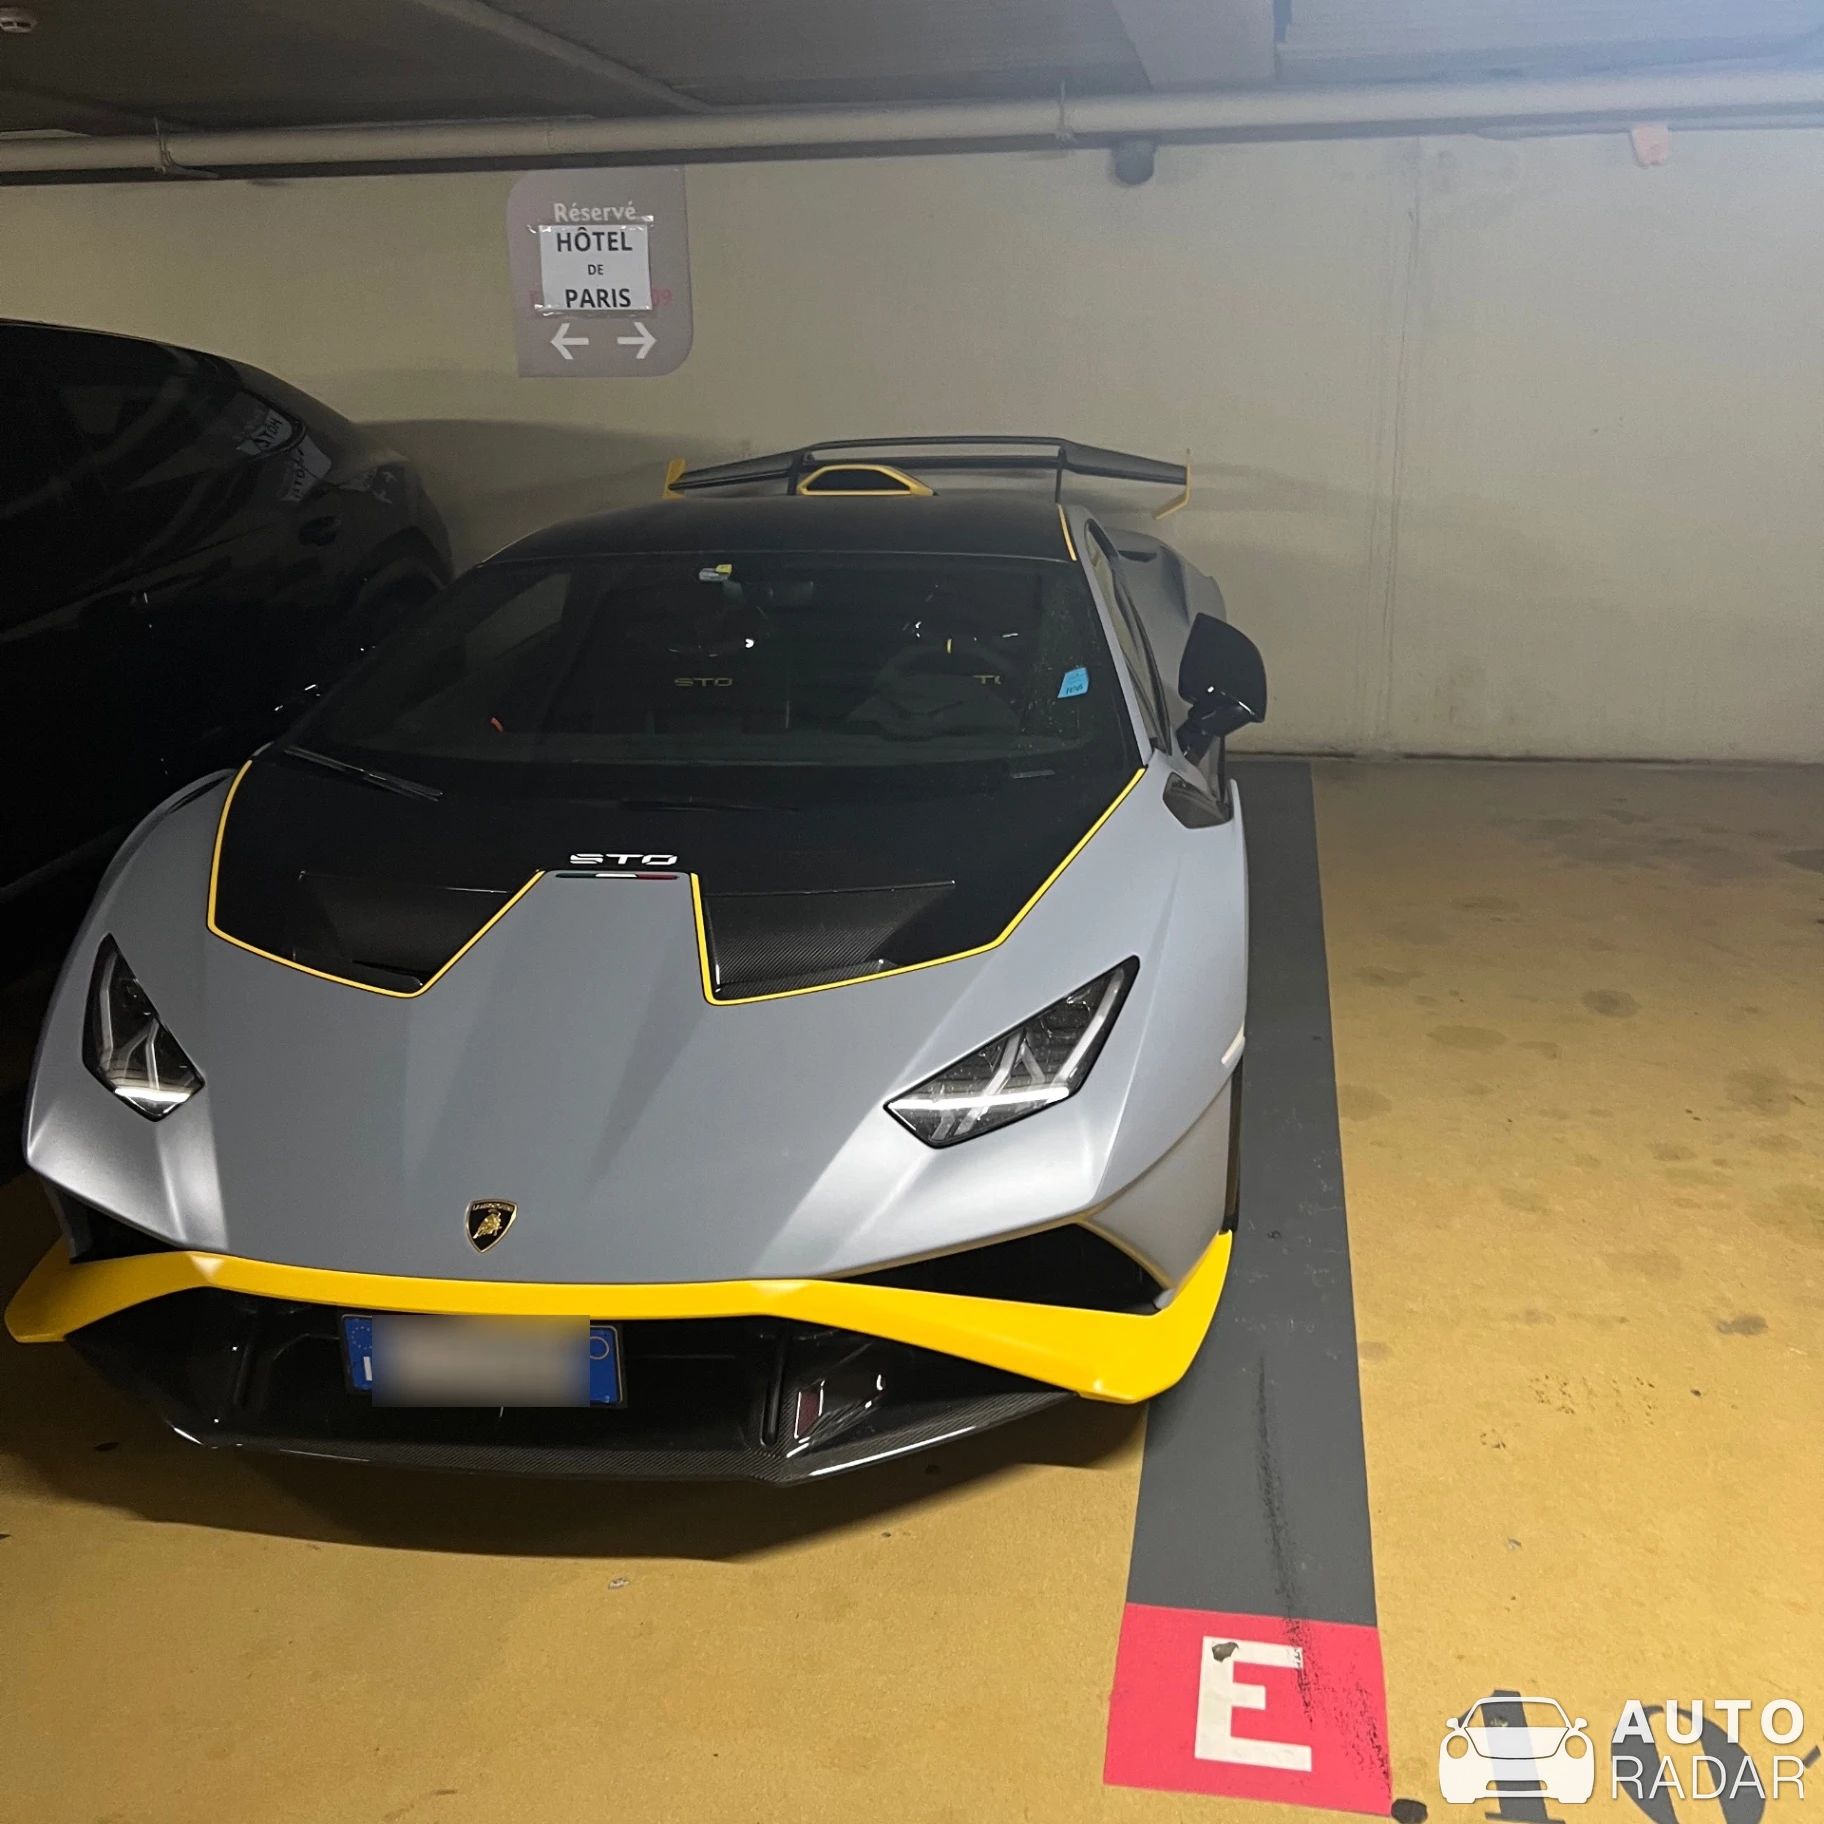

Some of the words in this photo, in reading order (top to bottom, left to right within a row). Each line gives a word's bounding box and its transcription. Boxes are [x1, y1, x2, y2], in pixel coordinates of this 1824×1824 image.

[554, 201, 636, 223] Réservé
[556, 227, 633, 252] HÔTEL
[587, 264, 604, 276] DE
[565, 288, 632, 308] PARIS
[674, 677, 733, 688] STO
[570, 853, 678, 866] STO
[1194, 1635, 1312, 1773] E
